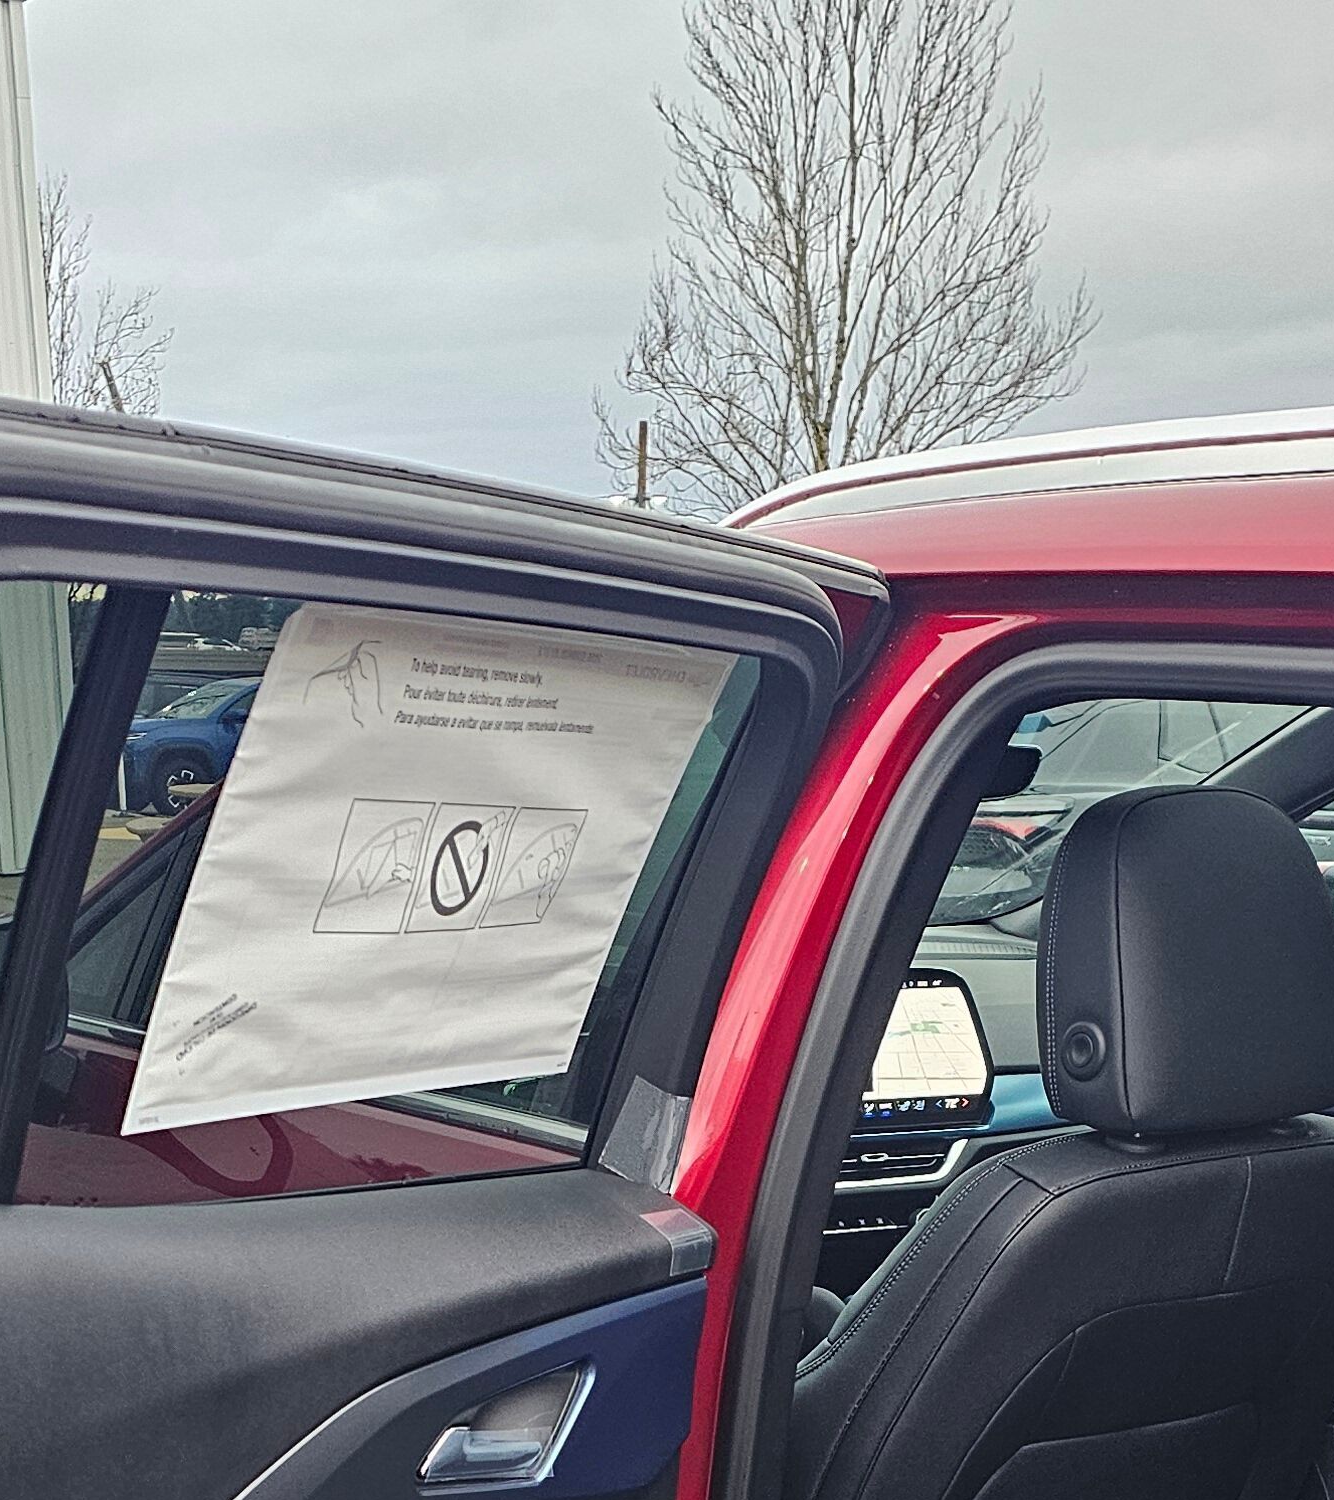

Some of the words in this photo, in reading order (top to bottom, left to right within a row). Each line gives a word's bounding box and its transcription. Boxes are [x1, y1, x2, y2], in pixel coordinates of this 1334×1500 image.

[411, 657, 420, 673] To
[421, 659, 439, 677] help
[439, 662, 461, 677] avoid
[491, 669, 518, 683] remove
[403, 683, 423, 699] Pour
[394, 710, 414, 724] Para
